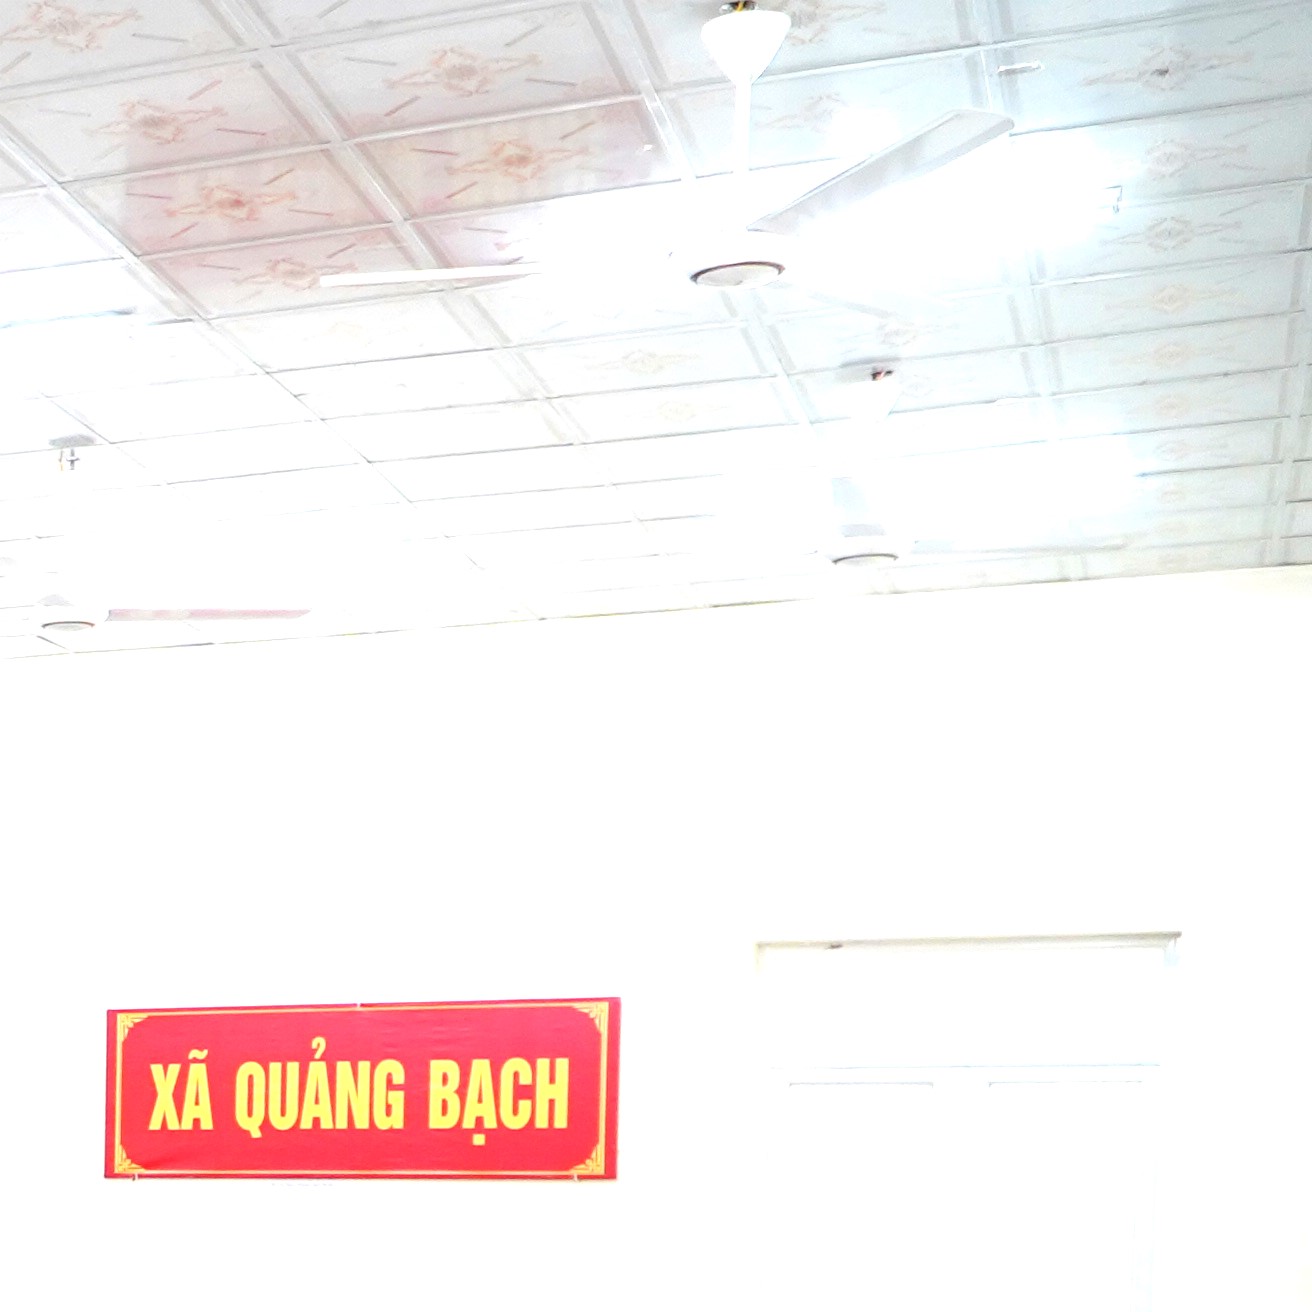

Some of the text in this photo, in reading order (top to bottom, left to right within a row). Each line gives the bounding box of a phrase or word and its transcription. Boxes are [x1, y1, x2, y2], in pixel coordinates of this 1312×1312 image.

[148, 1037, 570, 1146] XÃ QUẢNG BẠCH
